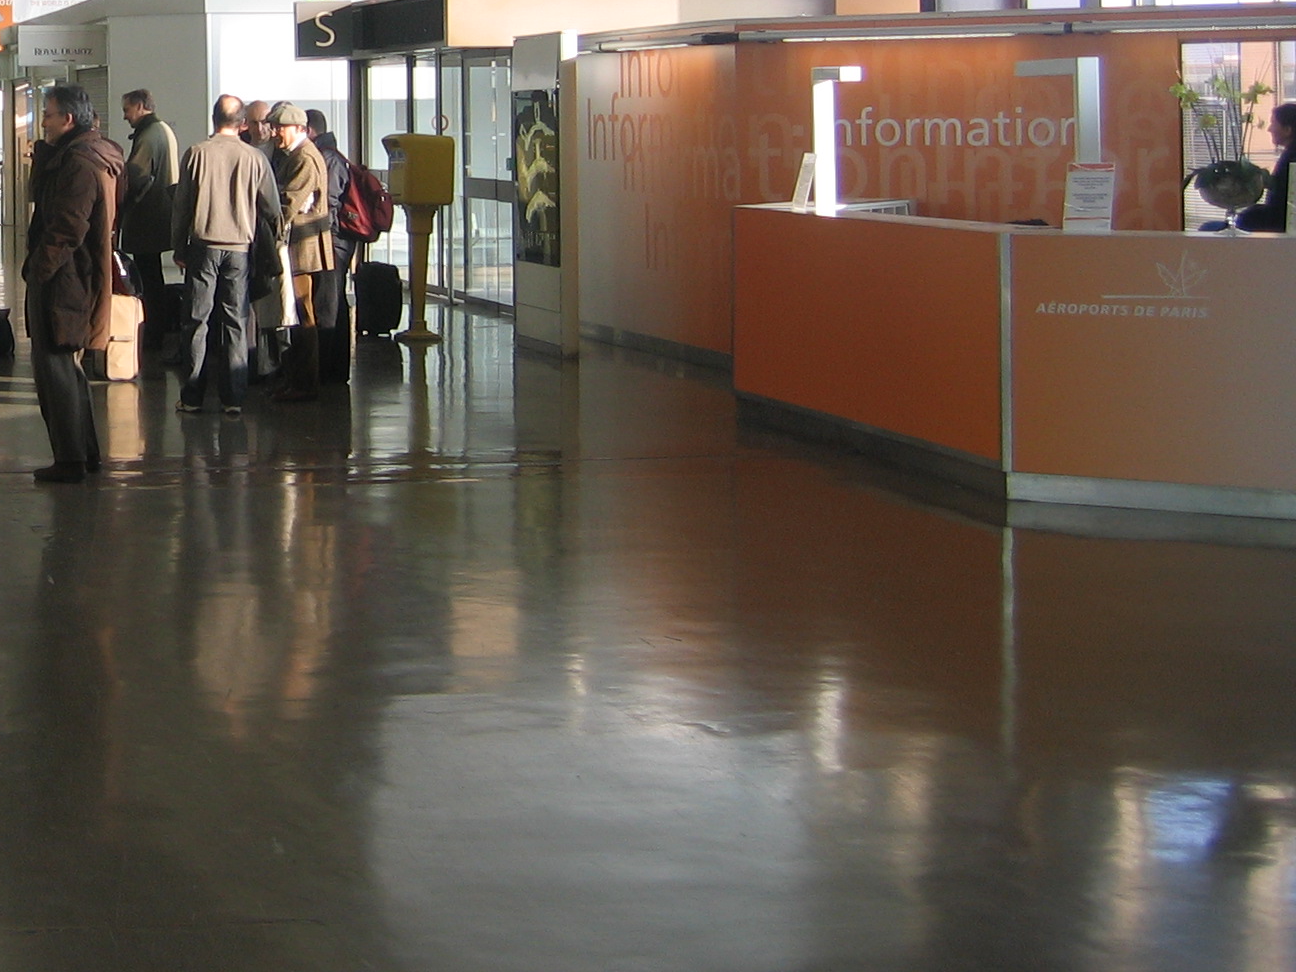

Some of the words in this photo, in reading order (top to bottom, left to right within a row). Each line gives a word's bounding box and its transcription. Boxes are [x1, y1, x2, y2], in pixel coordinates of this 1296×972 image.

[315, 11, 336, 47] S
[835, 106, 1076, 147] nformation
[1035, 300, 1129, 316] AÉROPORTS
[1134, 305, 1155, 317] DE
[1159, 306, 1209, 318] PARIS
